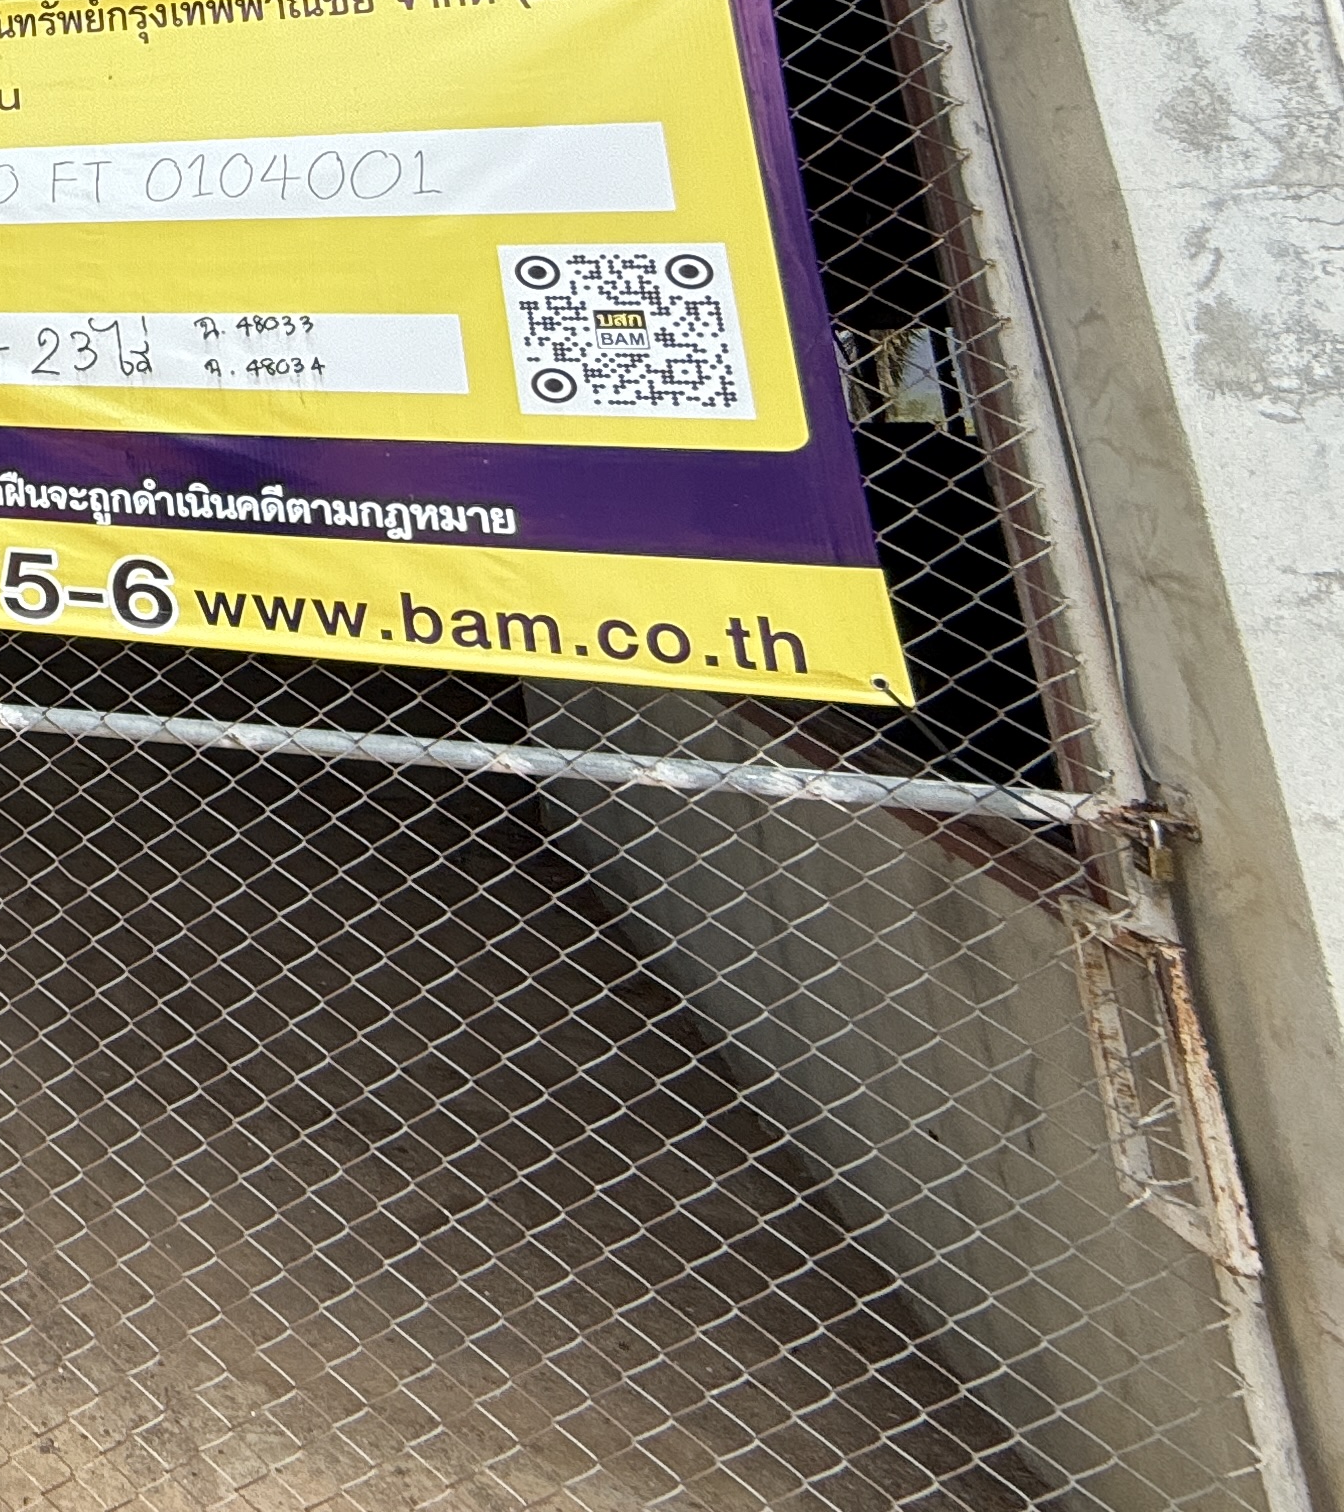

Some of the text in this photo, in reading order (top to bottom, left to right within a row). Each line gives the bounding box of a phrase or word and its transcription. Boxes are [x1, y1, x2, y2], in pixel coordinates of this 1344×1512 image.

[50, 160, 112, 204] FT
[144, 149, 444, 204] 0104001
[595, 311, 644, 329] บสก
[600, 331, 647, 347] BAM
[194, 584, 809, 676] www.bam.co.th
